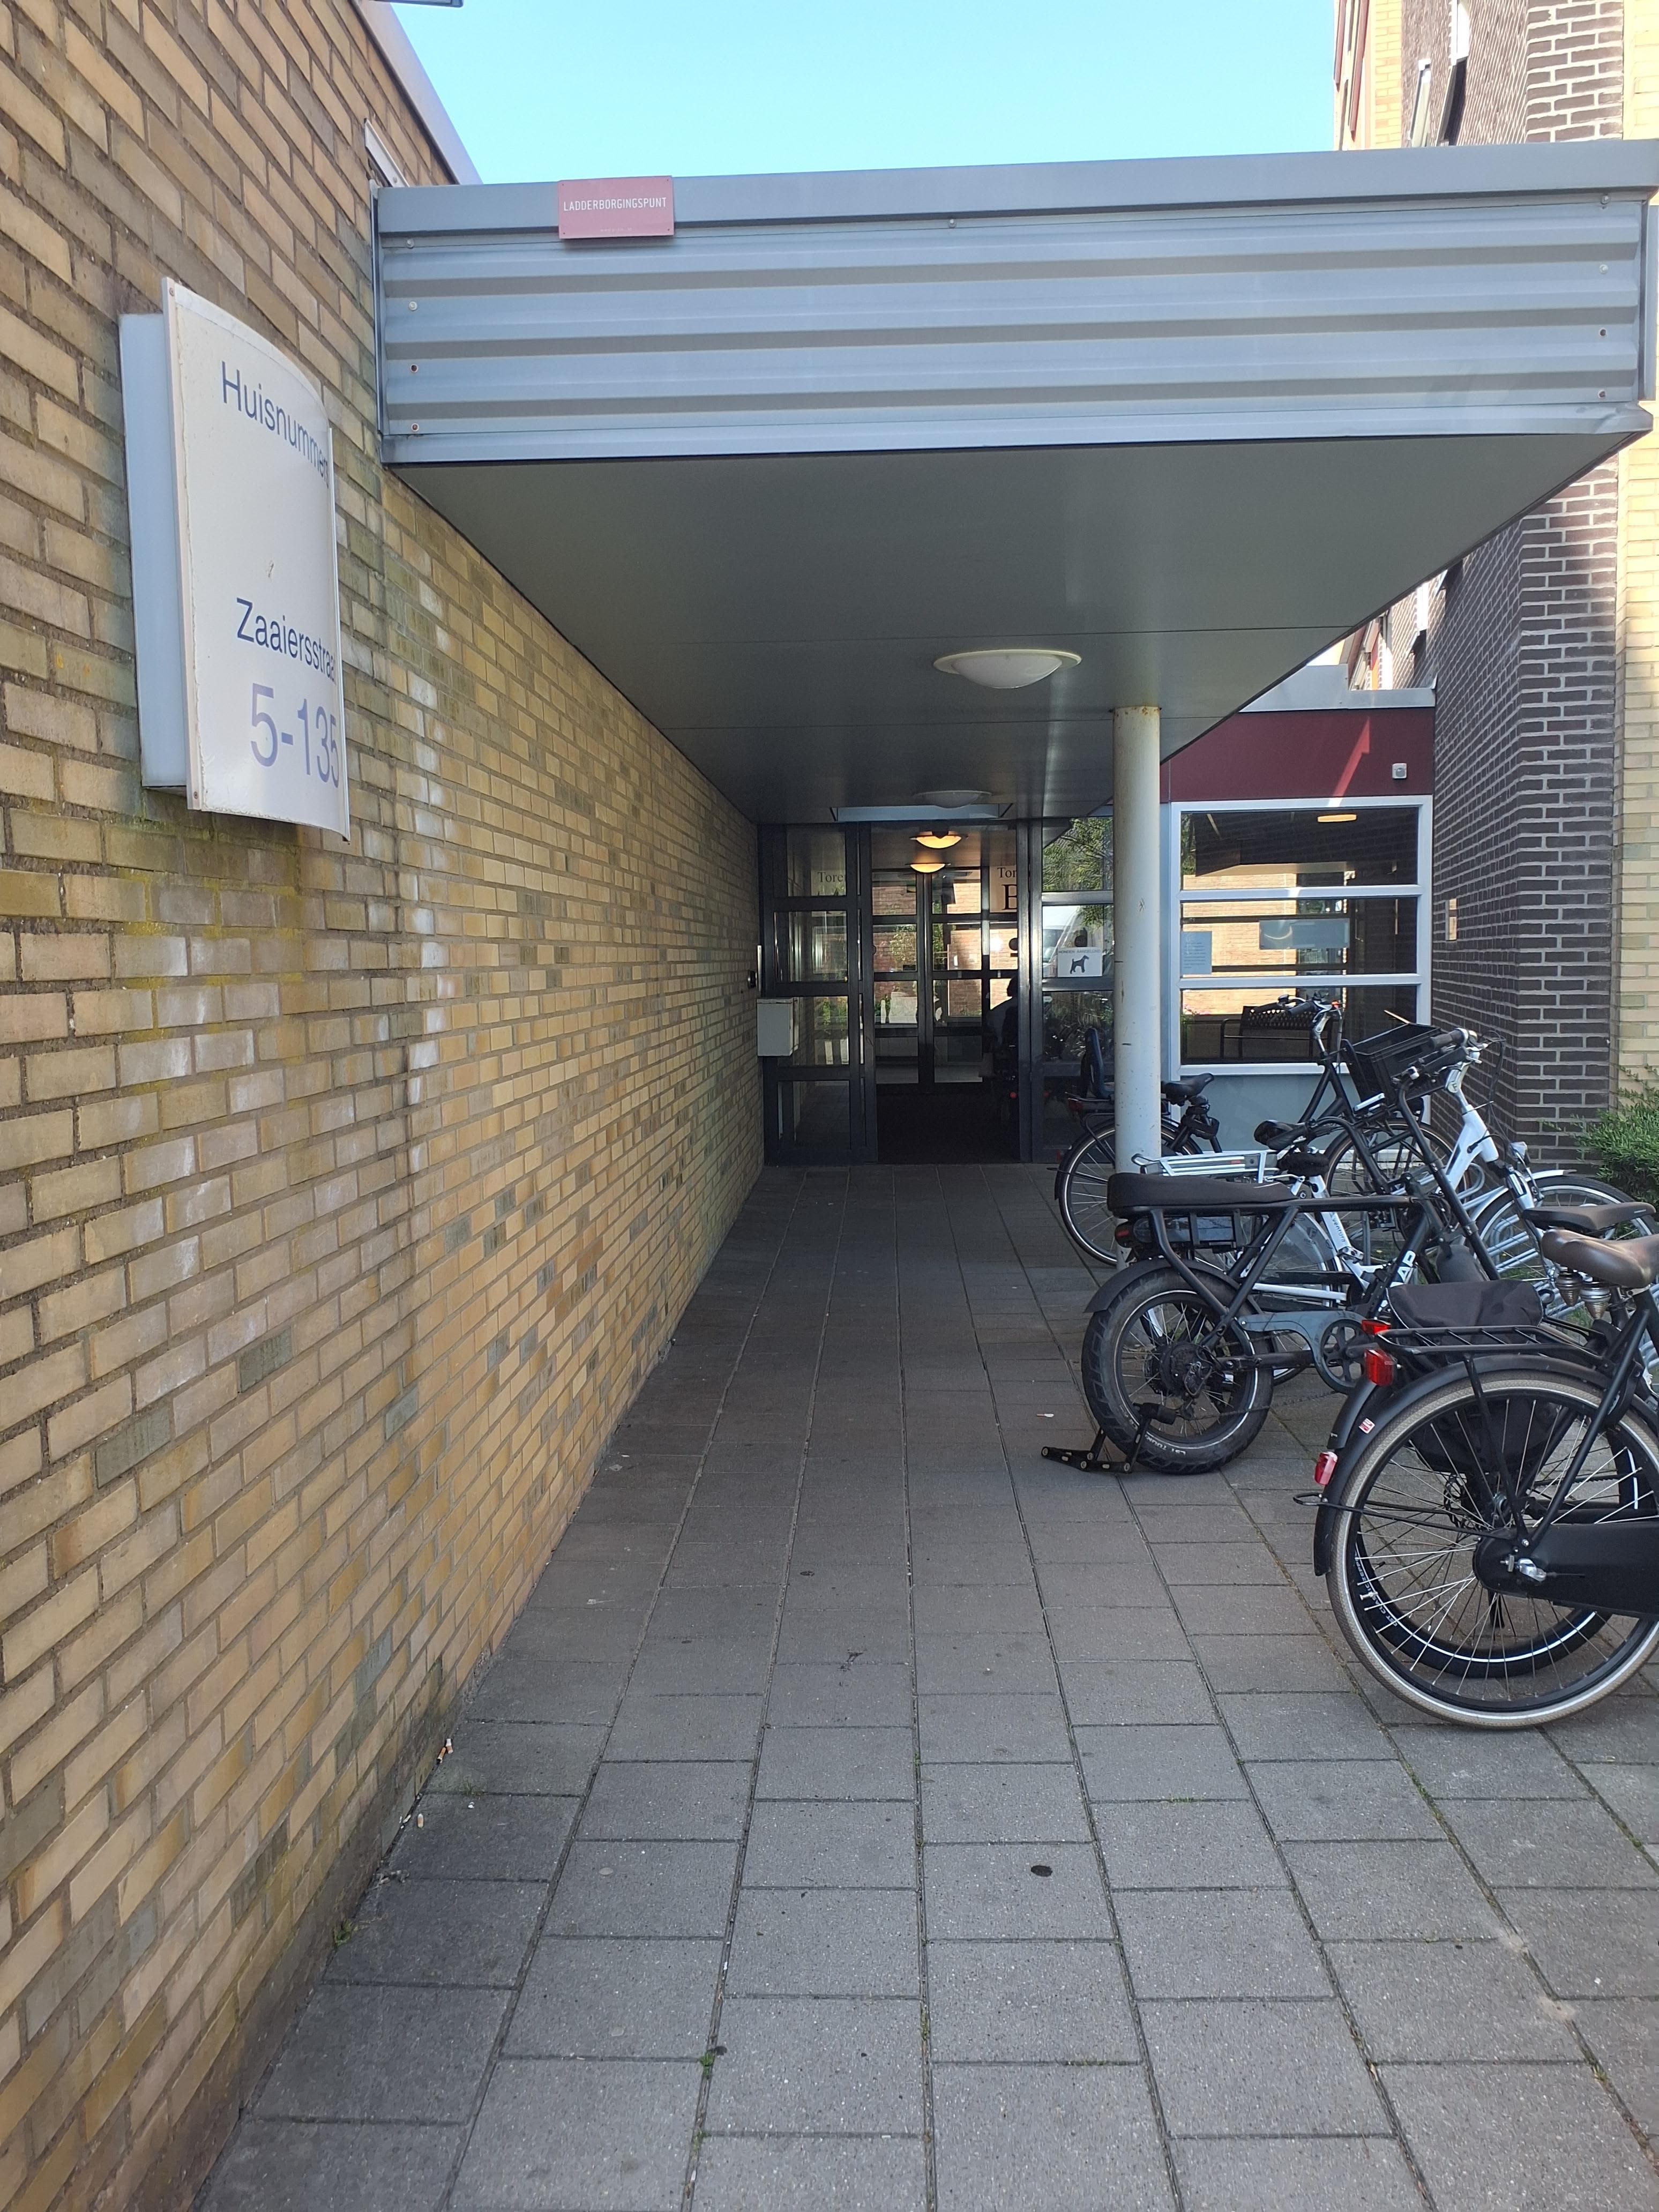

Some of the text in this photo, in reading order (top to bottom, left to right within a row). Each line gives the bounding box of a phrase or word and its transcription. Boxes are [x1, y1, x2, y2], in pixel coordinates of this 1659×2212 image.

[564, 197, 667, 212] LADDERBORGINGSPUNT
[220, 360, 330, 489] Huisnummers
[250, 682, 340, 788] 5-135
